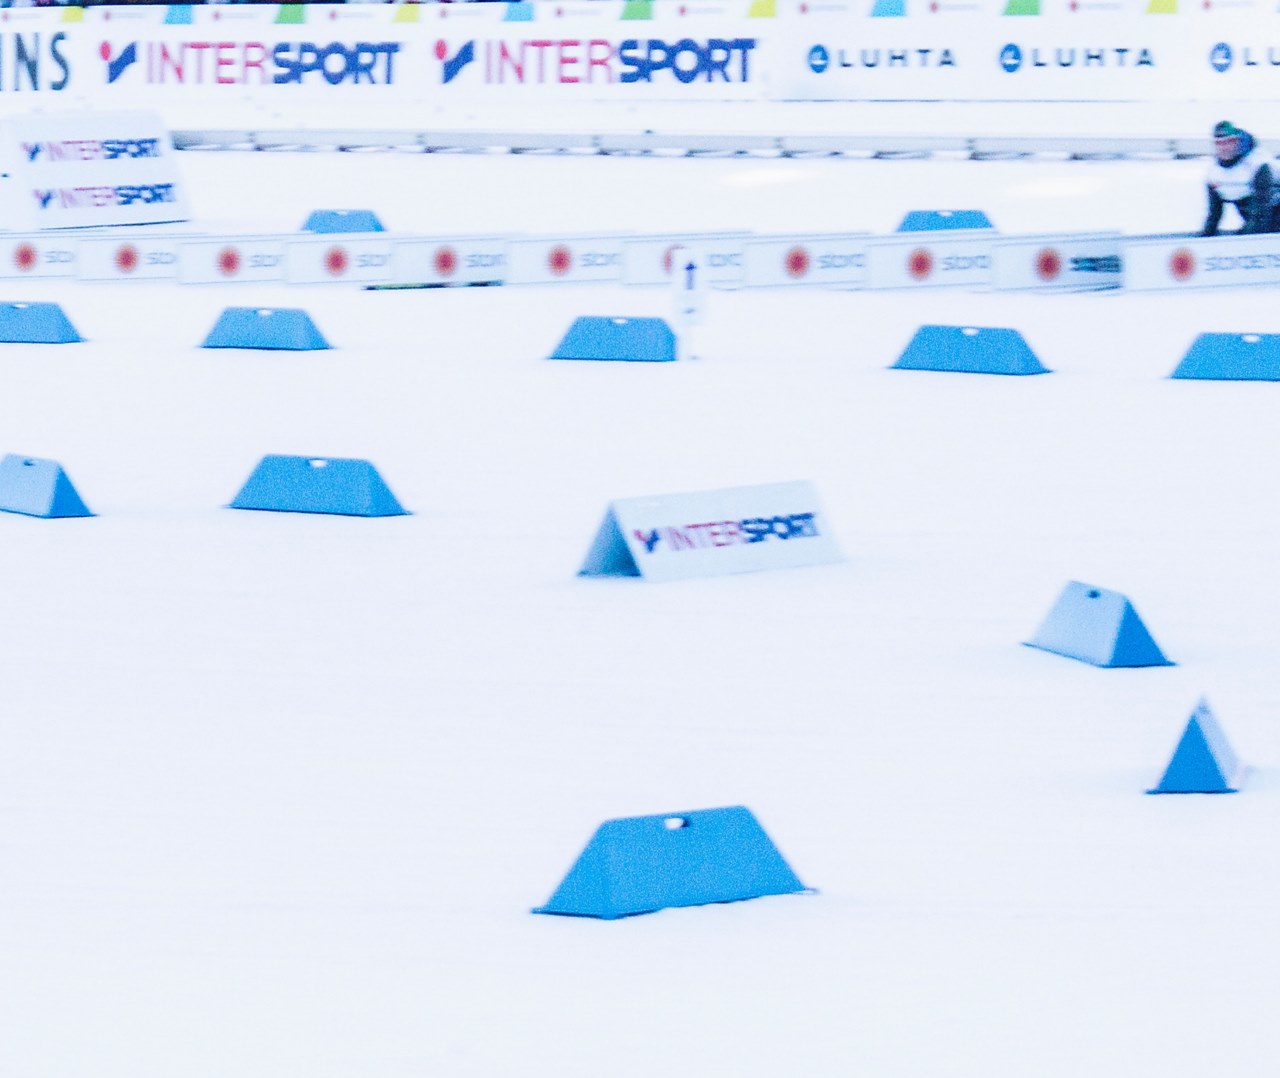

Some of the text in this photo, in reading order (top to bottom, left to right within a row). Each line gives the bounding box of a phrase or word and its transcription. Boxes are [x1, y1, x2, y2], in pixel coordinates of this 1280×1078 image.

[146, 41, 401, 85] INTERSPORT
[484, 38, 757, 84] INTERSPORT
[839, 48, 956, 68] LUHTA
[1031, 47, 1155, 67] LUHTA
[47, 138, 160, 161] INTERSPORT
[60, 183, 176, 208] INTERSPORT
[665, 512, 820, 552] INTERSPORT
